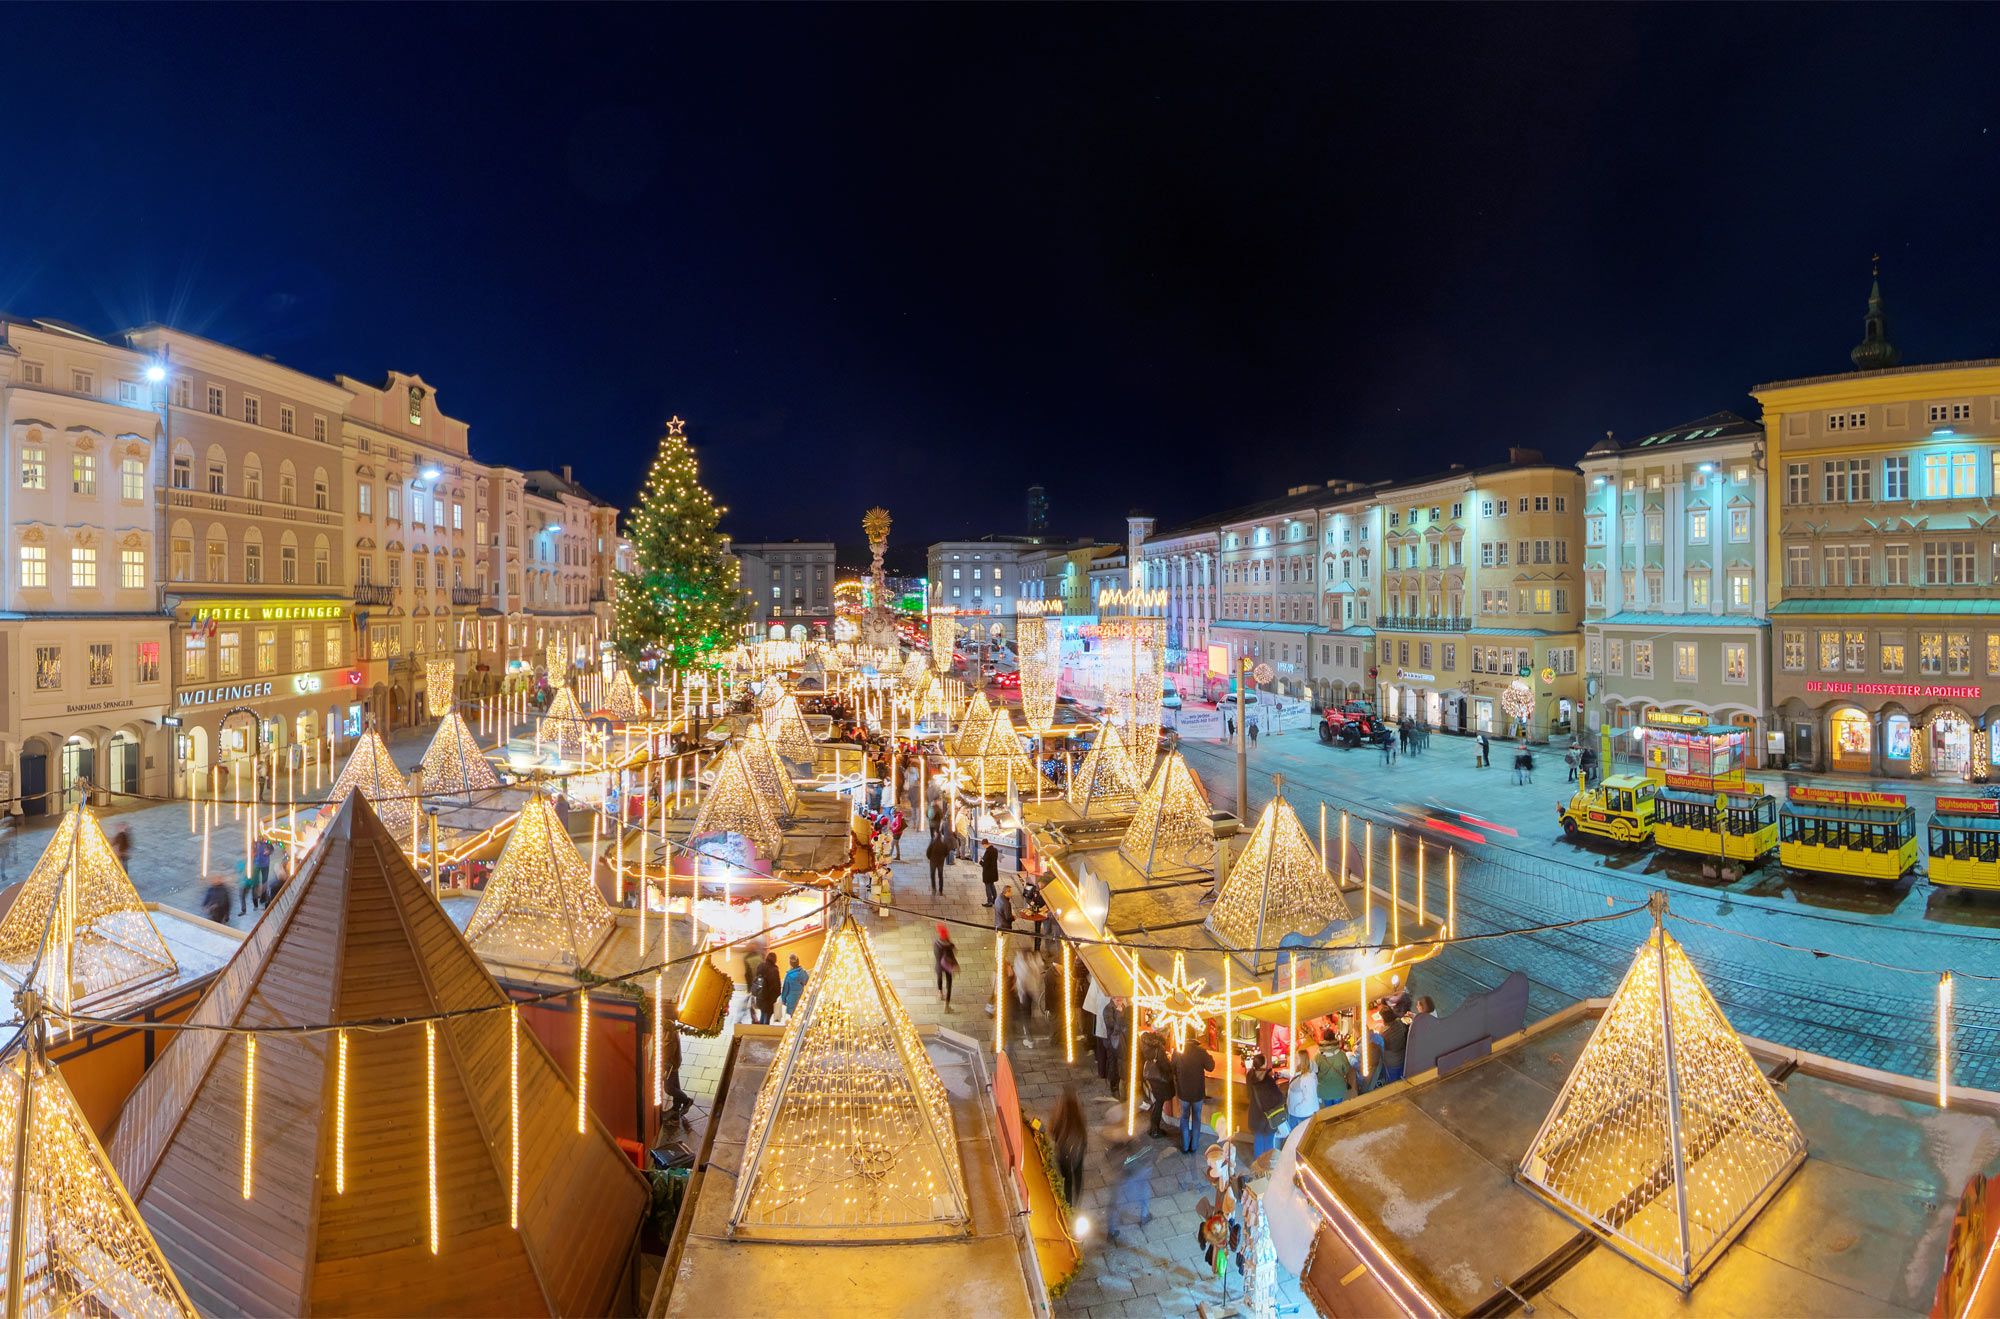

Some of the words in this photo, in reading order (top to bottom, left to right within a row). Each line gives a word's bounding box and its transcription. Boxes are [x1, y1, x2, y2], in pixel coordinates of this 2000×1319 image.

[198, 608, 251, 620] HOTEL
[262, 607, 341, 619] WOLFINGER
[179, 682, 272, 706] WOLFINGER
[1807, 681, 1822, 692] DIE
[1925, 686, 1981, 698] APOTHEKE
[1667, 774, 1713, 790] Stadtrundfahrt
[1938, 799, 1995, 811] Sightseeing-Tour
